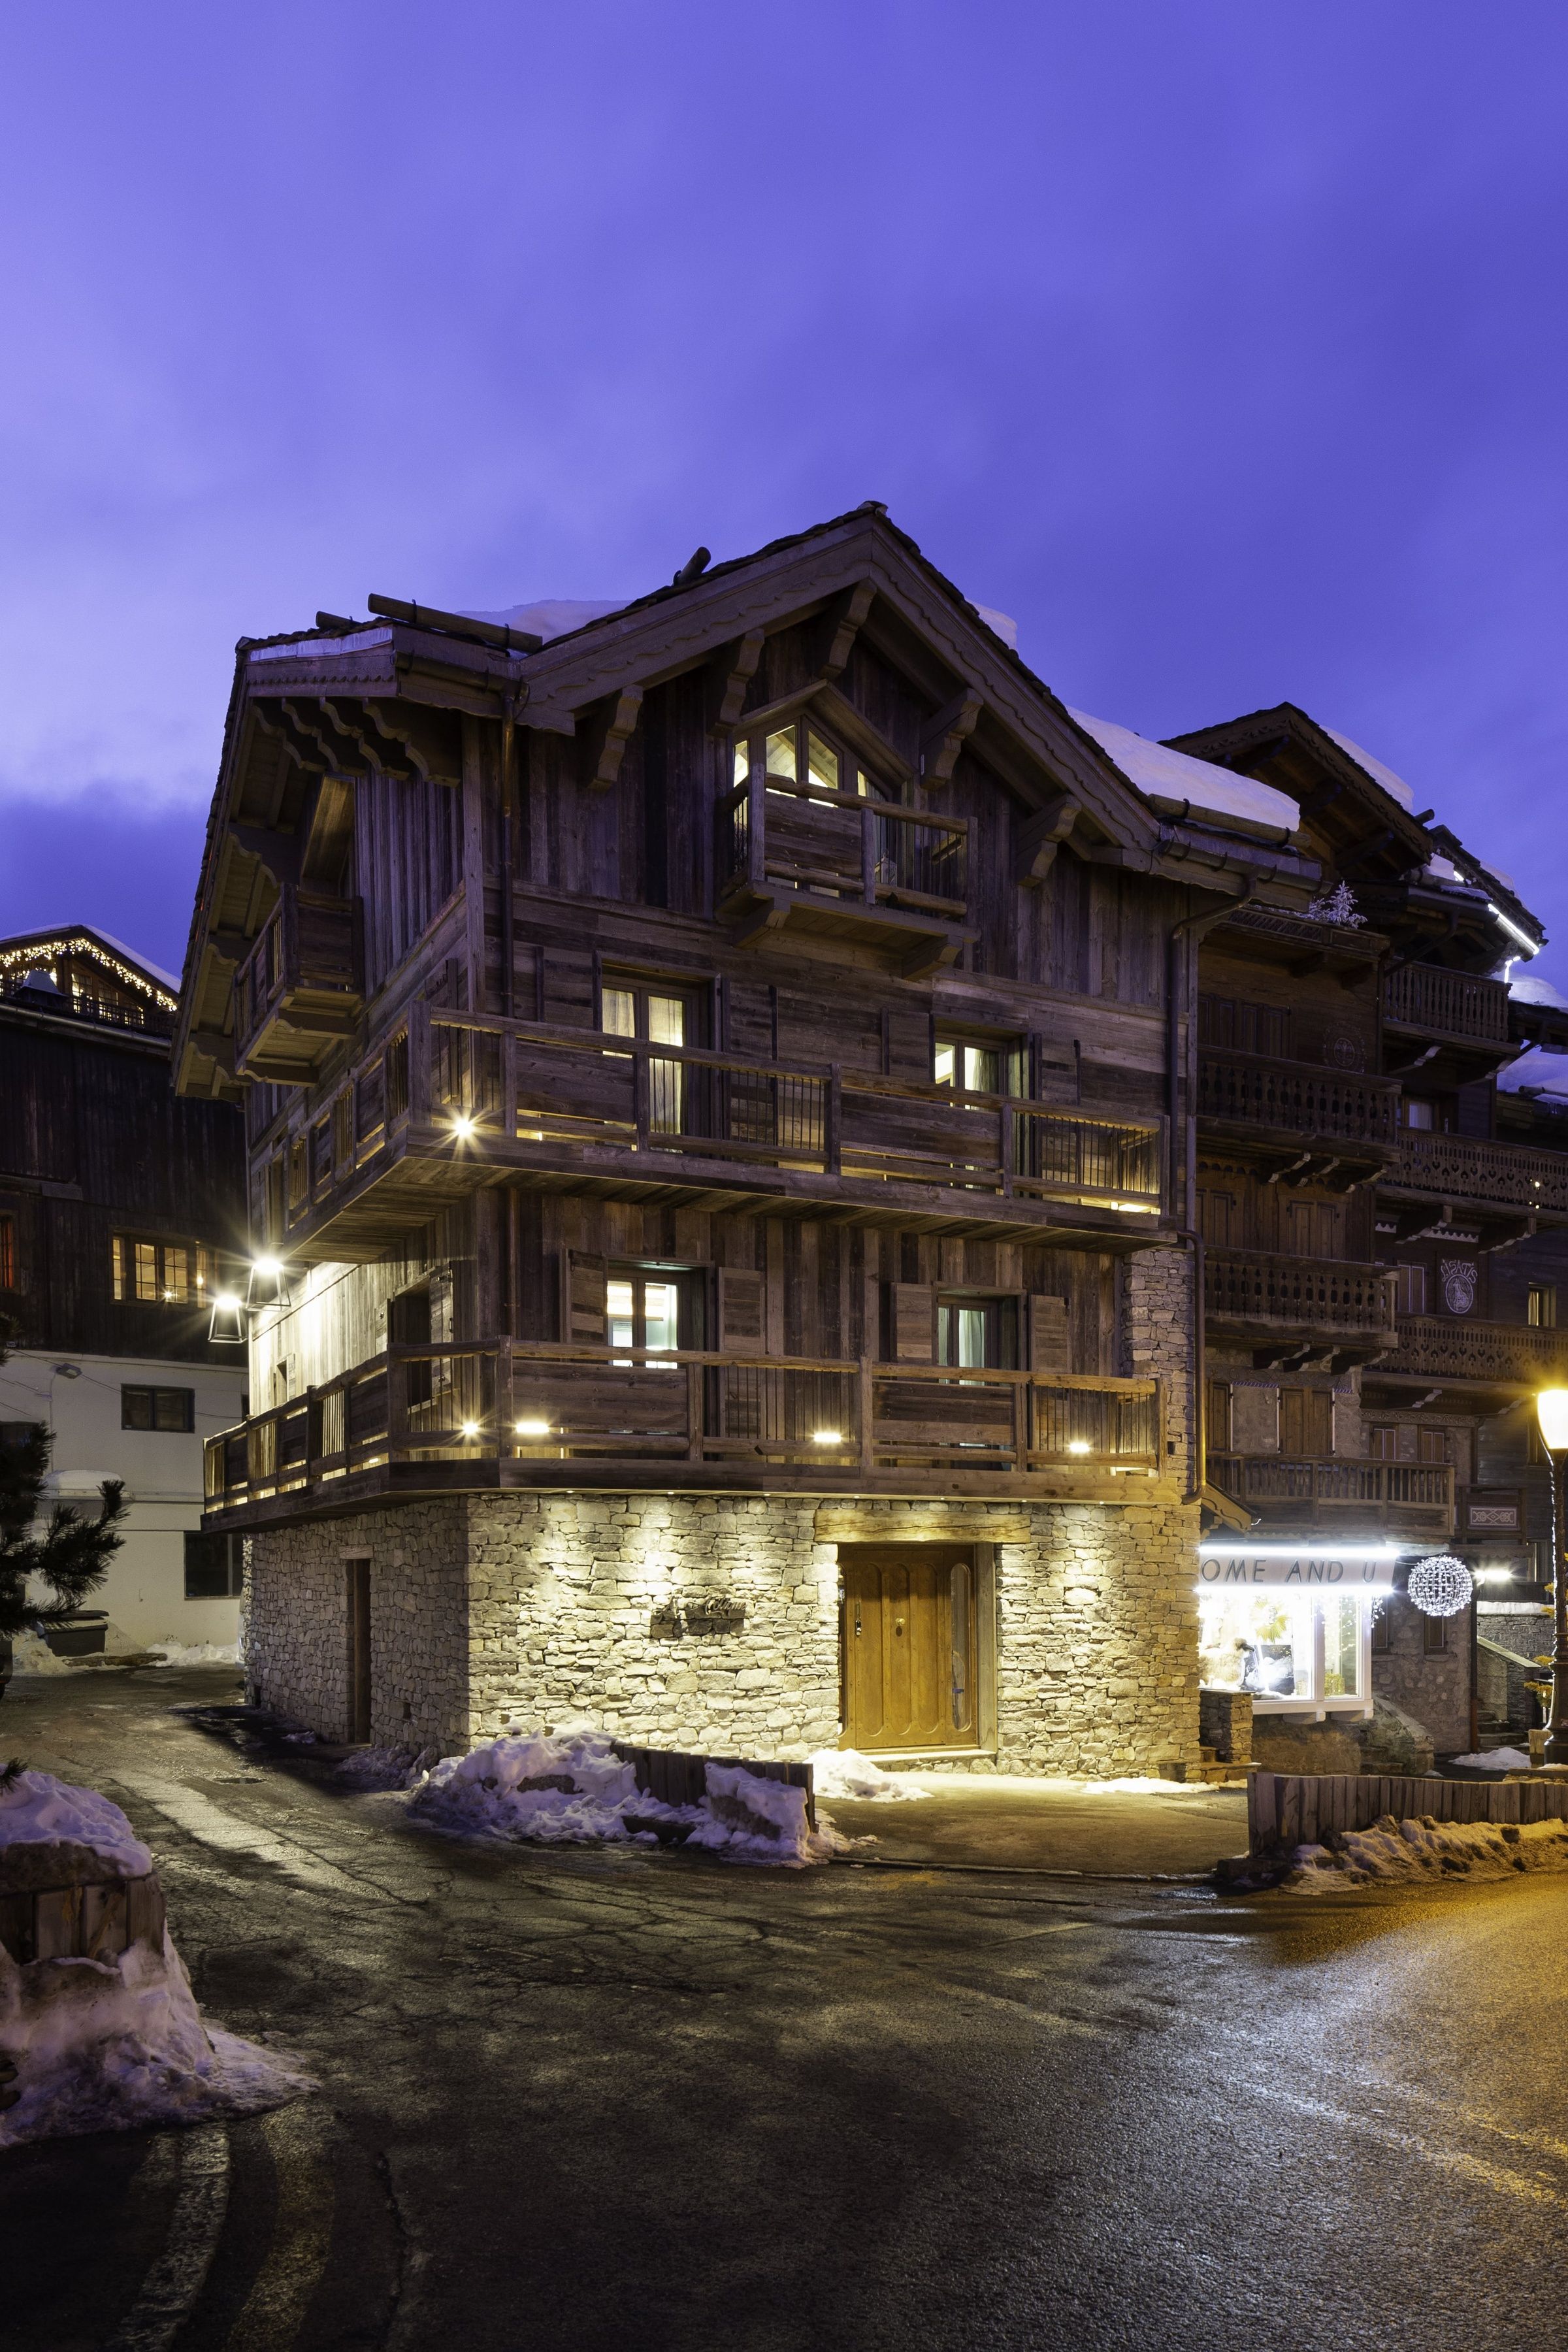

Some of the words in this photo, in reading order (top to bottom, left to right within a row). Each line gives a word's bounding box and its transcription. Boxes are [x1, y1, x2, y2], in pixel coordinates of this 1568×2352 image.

[1201, 1559, 1266, 1583] OME
[1284, 1560, 1344, 1584] AND
[1361, 1560, 1377, 1584] U
